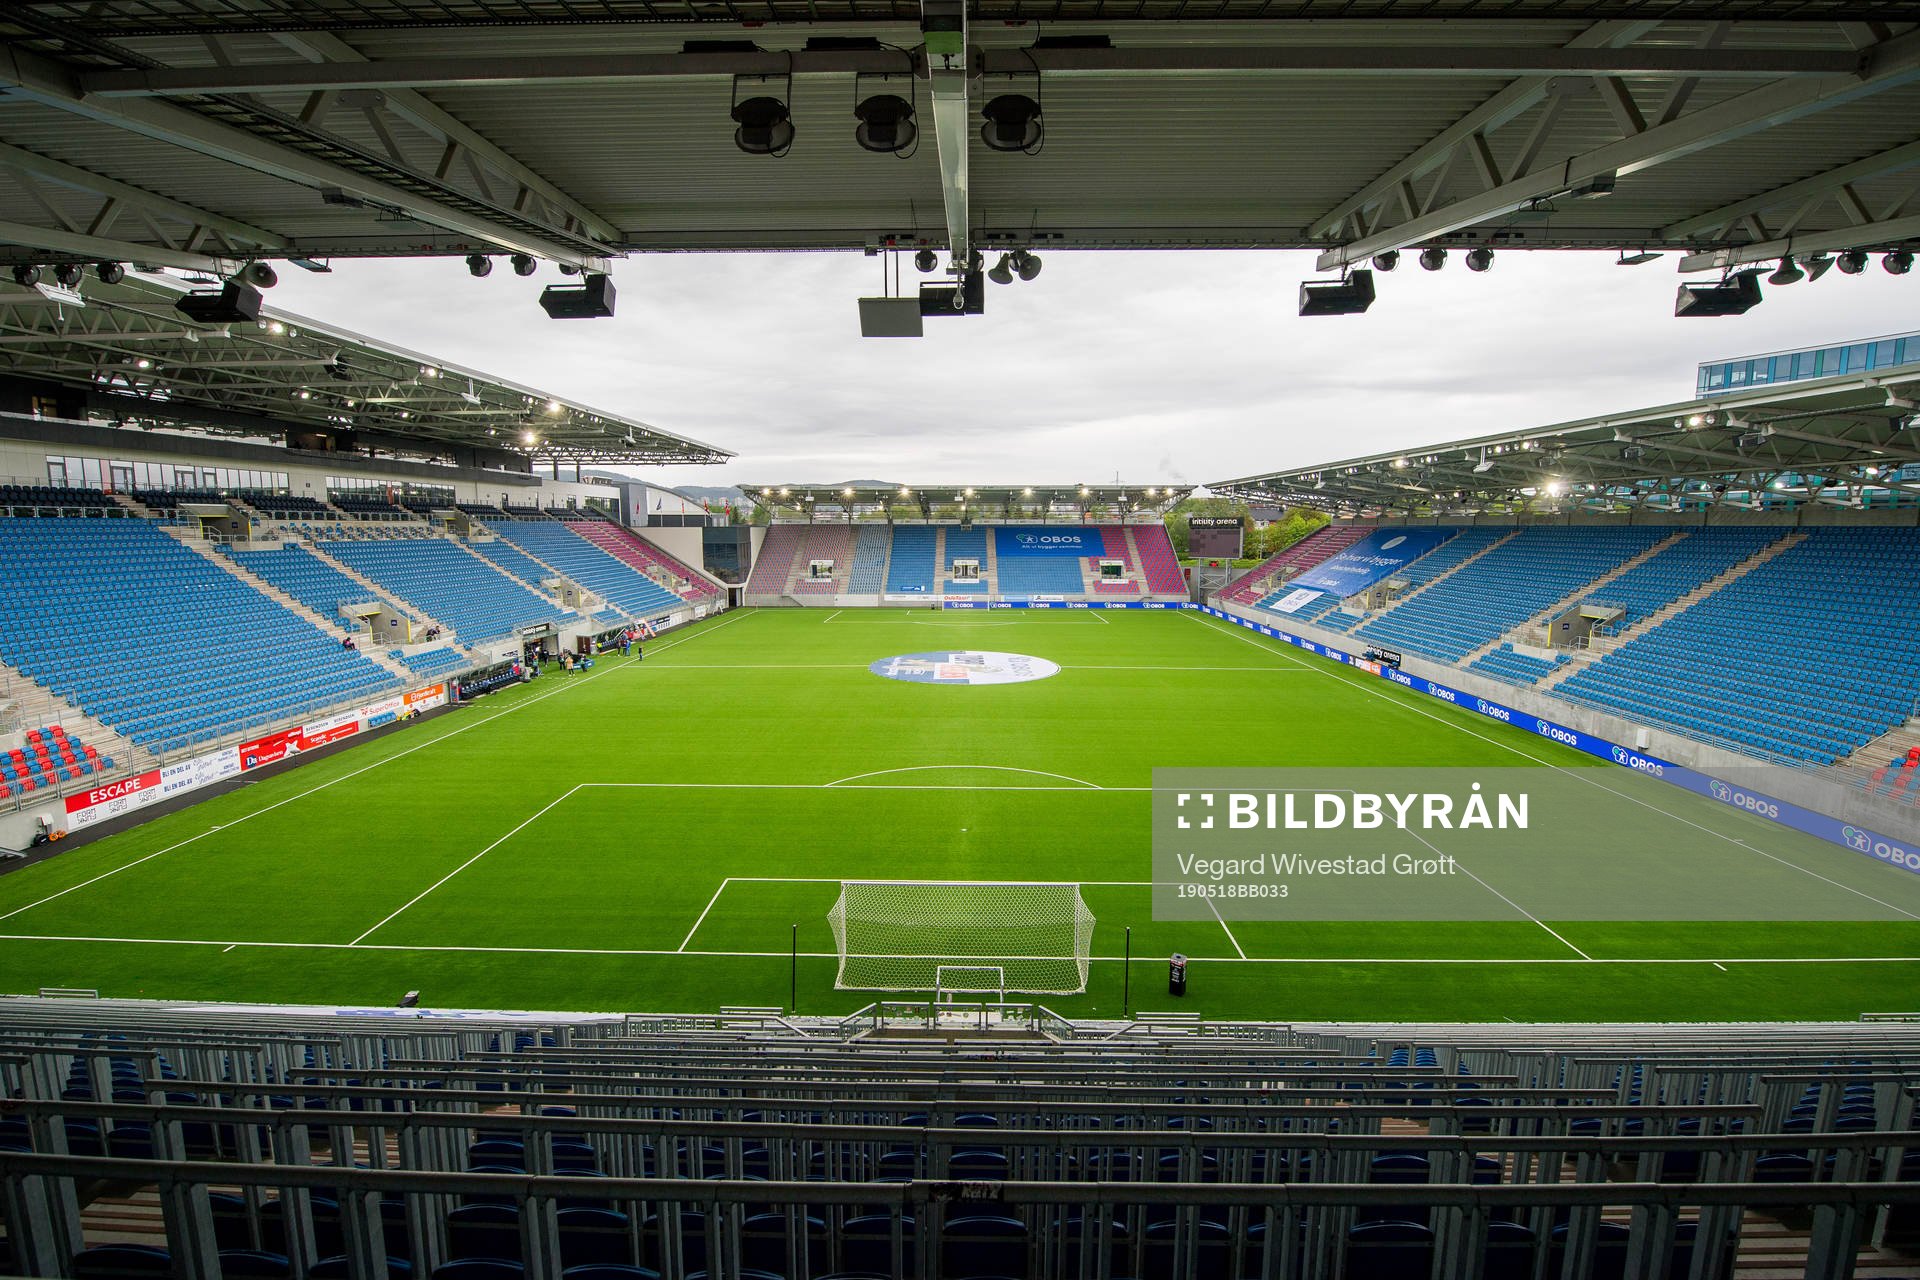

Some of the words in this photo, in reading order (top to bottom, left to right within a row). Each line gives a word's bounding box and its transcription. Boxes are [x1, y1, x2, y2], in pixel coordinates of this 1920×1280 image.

[1396, 673, 1411, 686] OBOS
[1437, 688, 1455, 702] OBOS
[1488, 706, 1510, 721] OBOS
[1550, 728, 1577, 745] OBOS
[1629, 756, 1664, 777] OBOS
[89, 778, 142, 803] ESCAPE
[76, 807, 96, 819] FORM
[1733, 792, 1779, 818] OBOS
[1874, 842, 1920, 870] OBO
